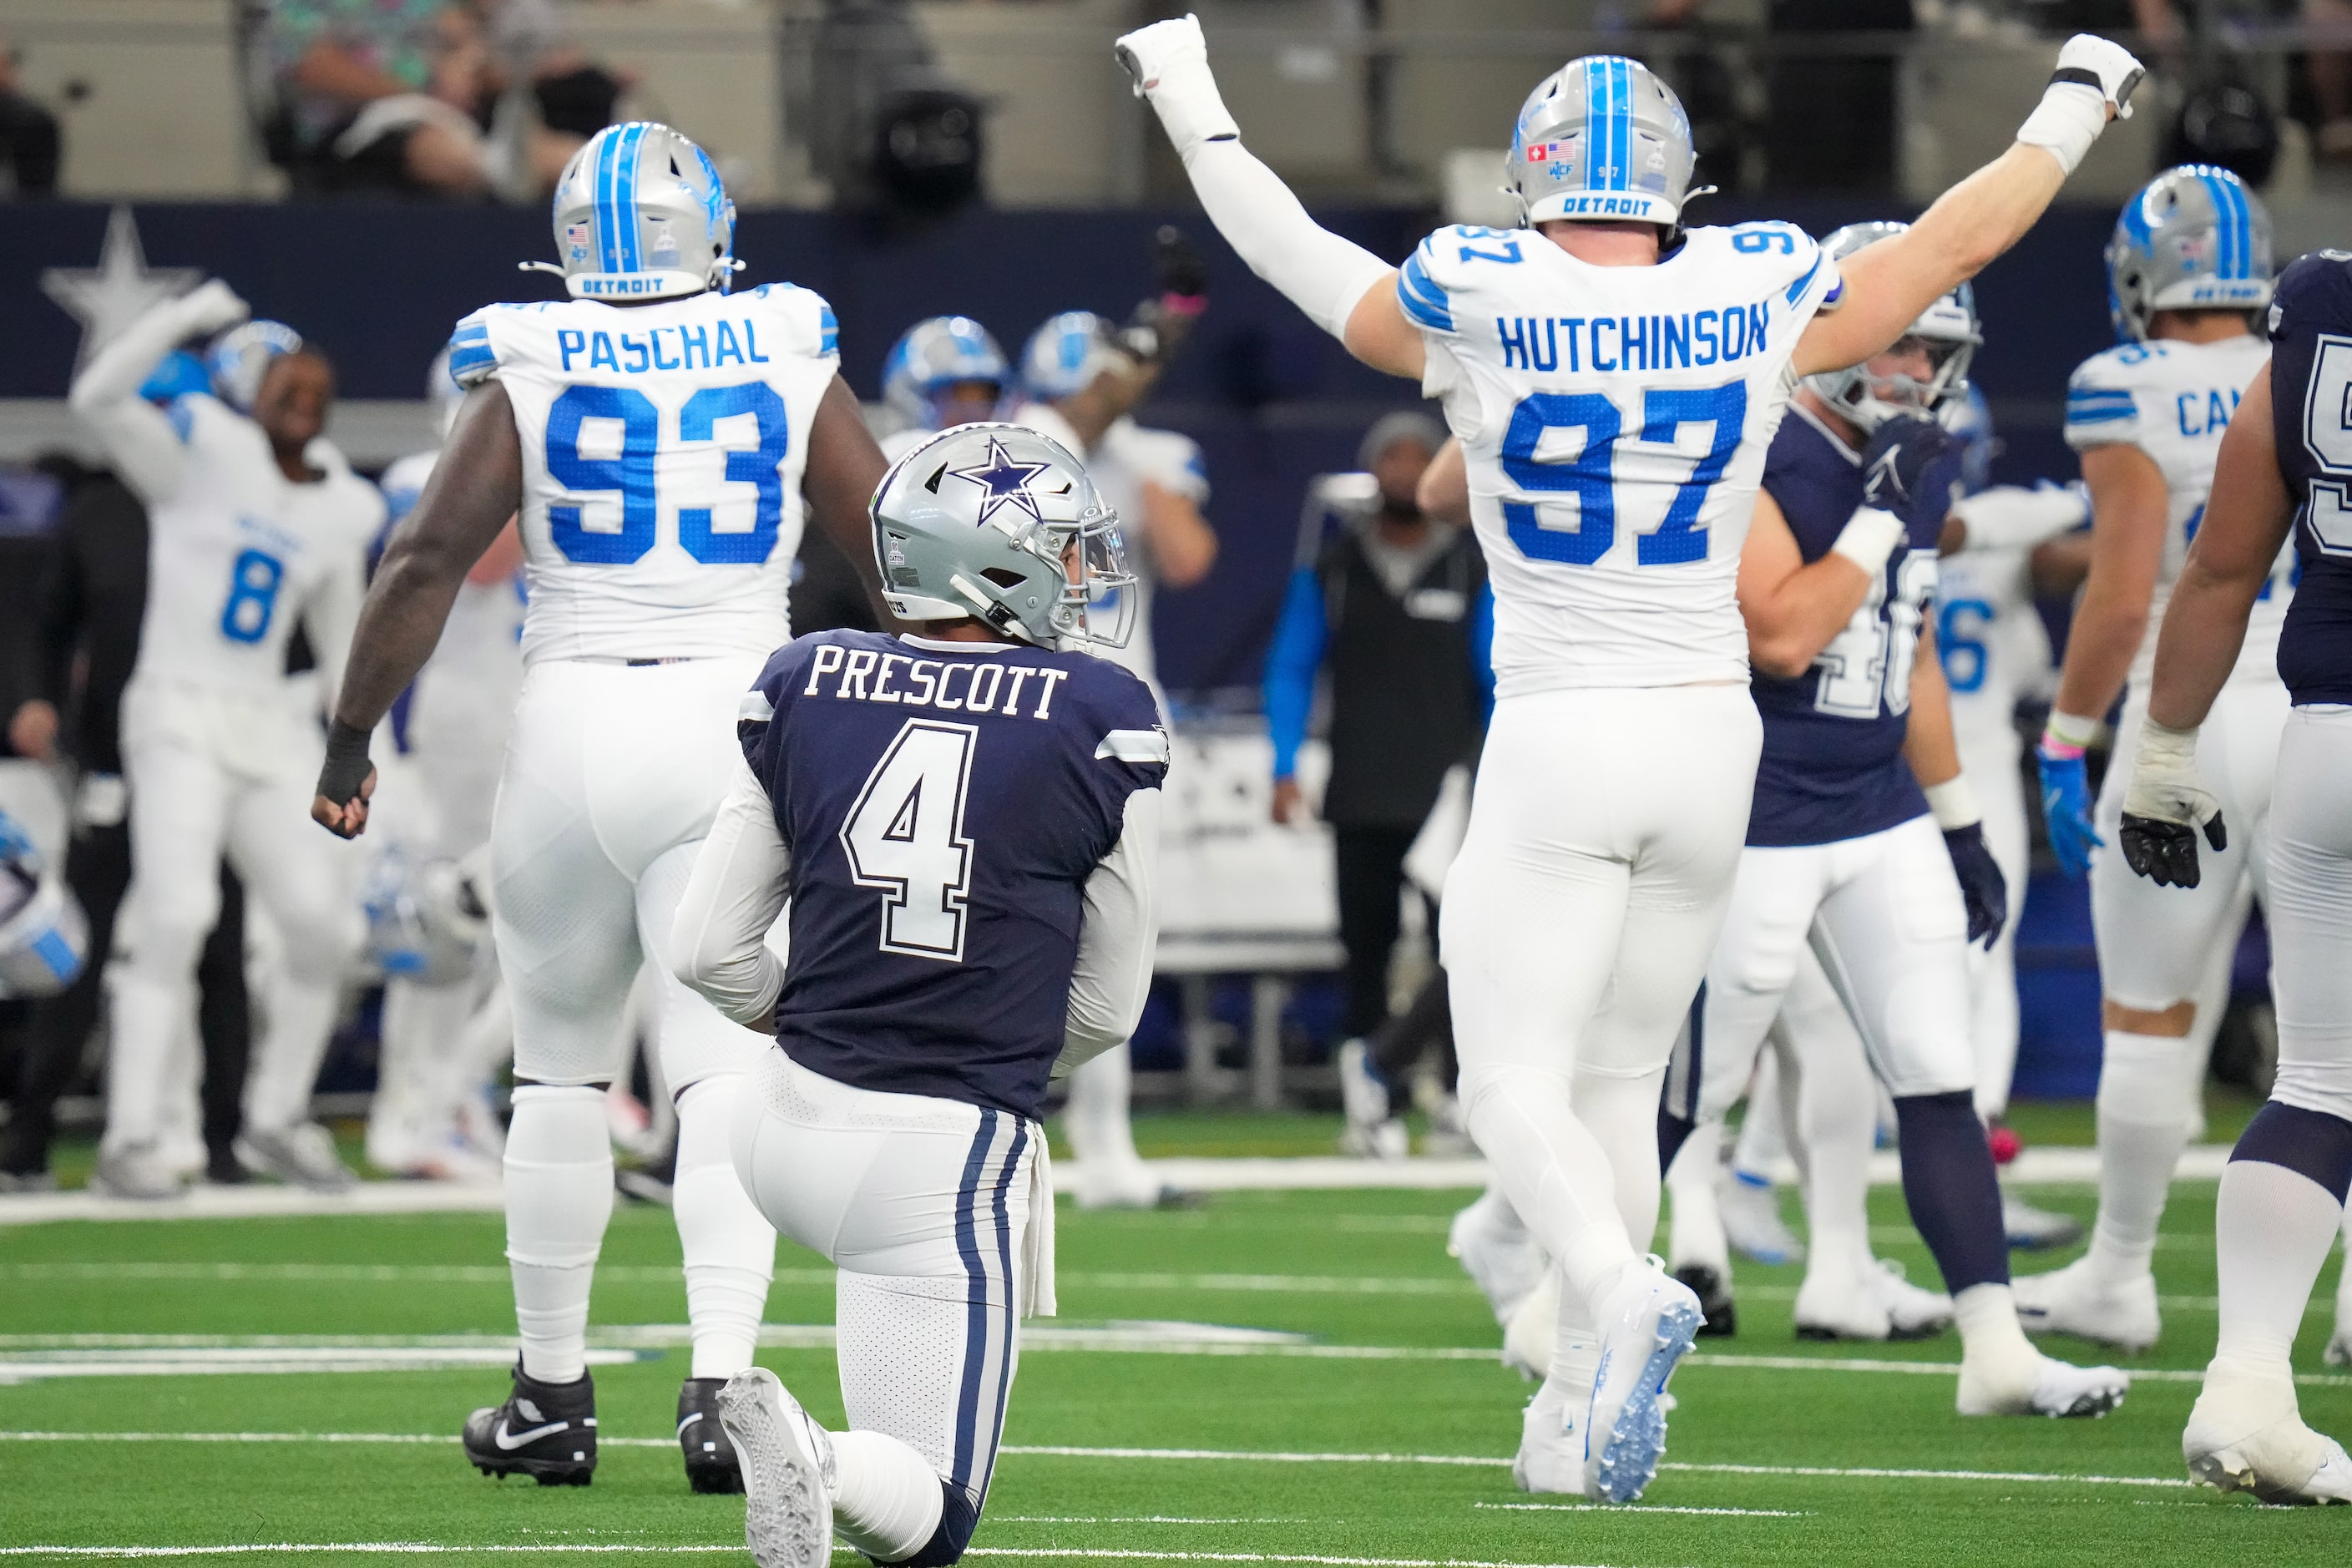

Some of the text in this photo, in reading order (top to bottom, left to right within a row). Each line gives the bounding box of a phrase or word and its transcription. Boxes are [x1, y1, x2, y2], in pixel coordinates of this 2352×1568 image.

[1563, 197, 1652, 216] DETROIT
[583, 278, 664, 294] DETROIT
[557, 319, 769, 373] PASCHAL
[1496, 300, 1771, 373] HUTCHINSON
[545, 380, 788, 565] 93
[1500, 377, 1748, 567] 97
[221, 548, 284, 645] 8
[803, 645, 1069, 720] PRESCOTT
[838, 716, 979, 963] 4
